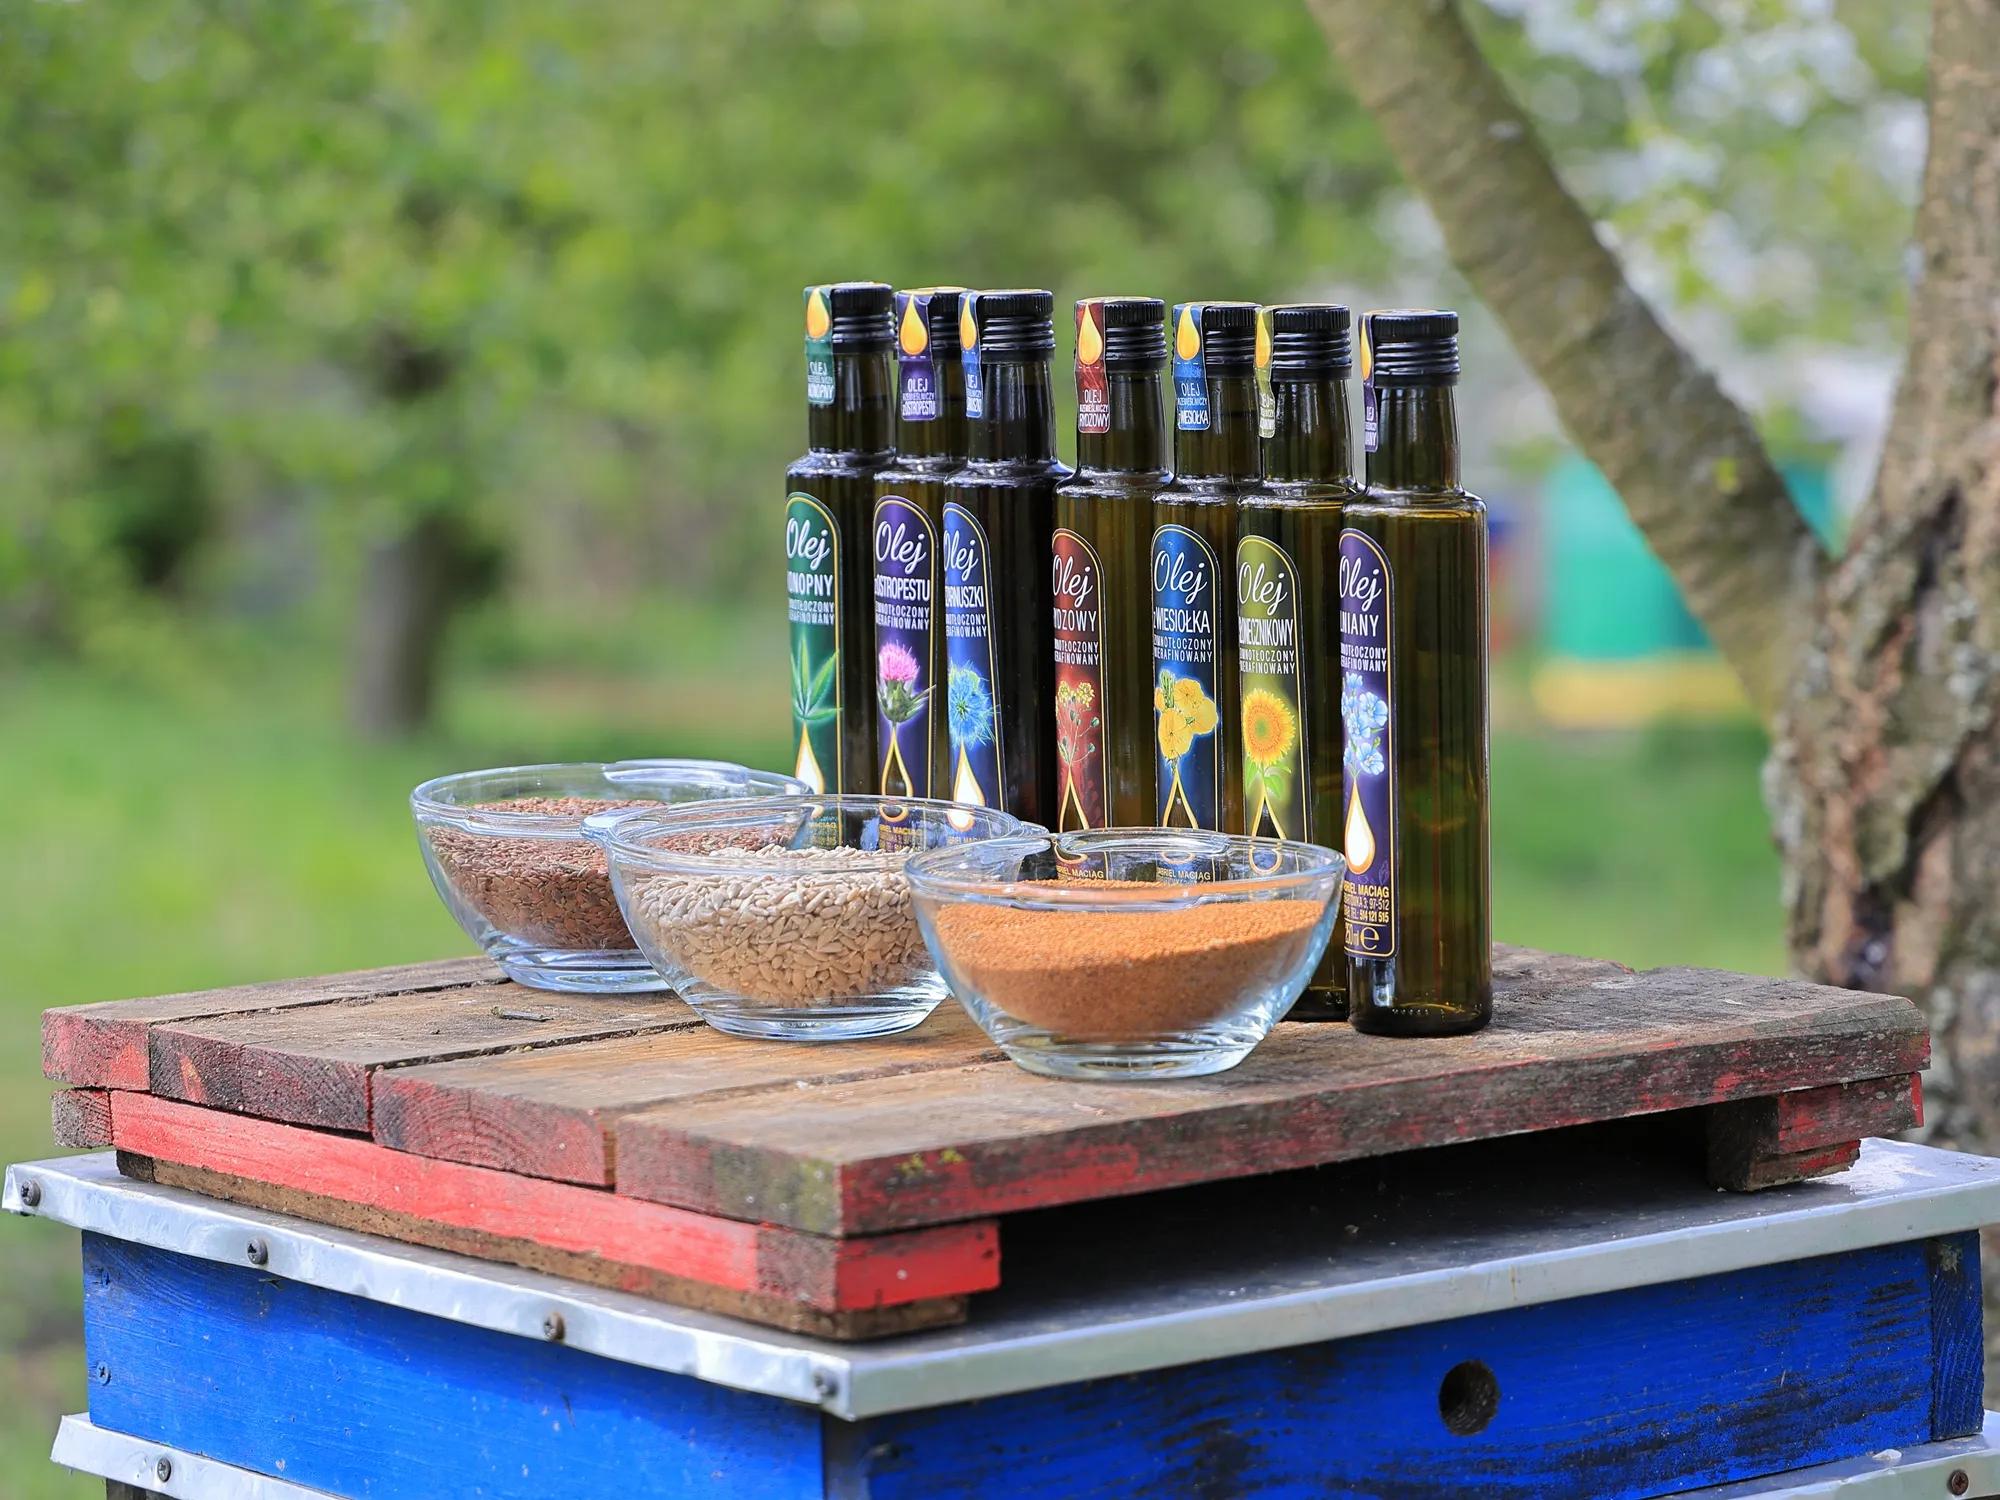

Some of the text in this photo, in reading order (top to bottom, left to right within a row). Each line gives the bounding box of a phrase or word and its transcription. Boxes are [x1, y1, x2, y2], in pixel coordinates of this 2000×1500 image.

[907, 378, 928, 393] OLEJ
[1084, 389, 1102, 404] OLEJ
[1180, 382, 1201, 397] OLEJ
[786, 517, 831, 570] Olej
[875, 520, 927, 575] Olej
[943, 529, 979, 582] Olej
[1052, 554, 1094, 608] Olej
[1154, 549, 1208, 605] Olej
[1238, 561, 1288, 616] Olej
[1339, 555, 1382, 612] Olej
[1368, 910, 1378, 923] 121
[1378, 911, 1390, 924] 515
[1369, 897, 1390, 911] 97-512
